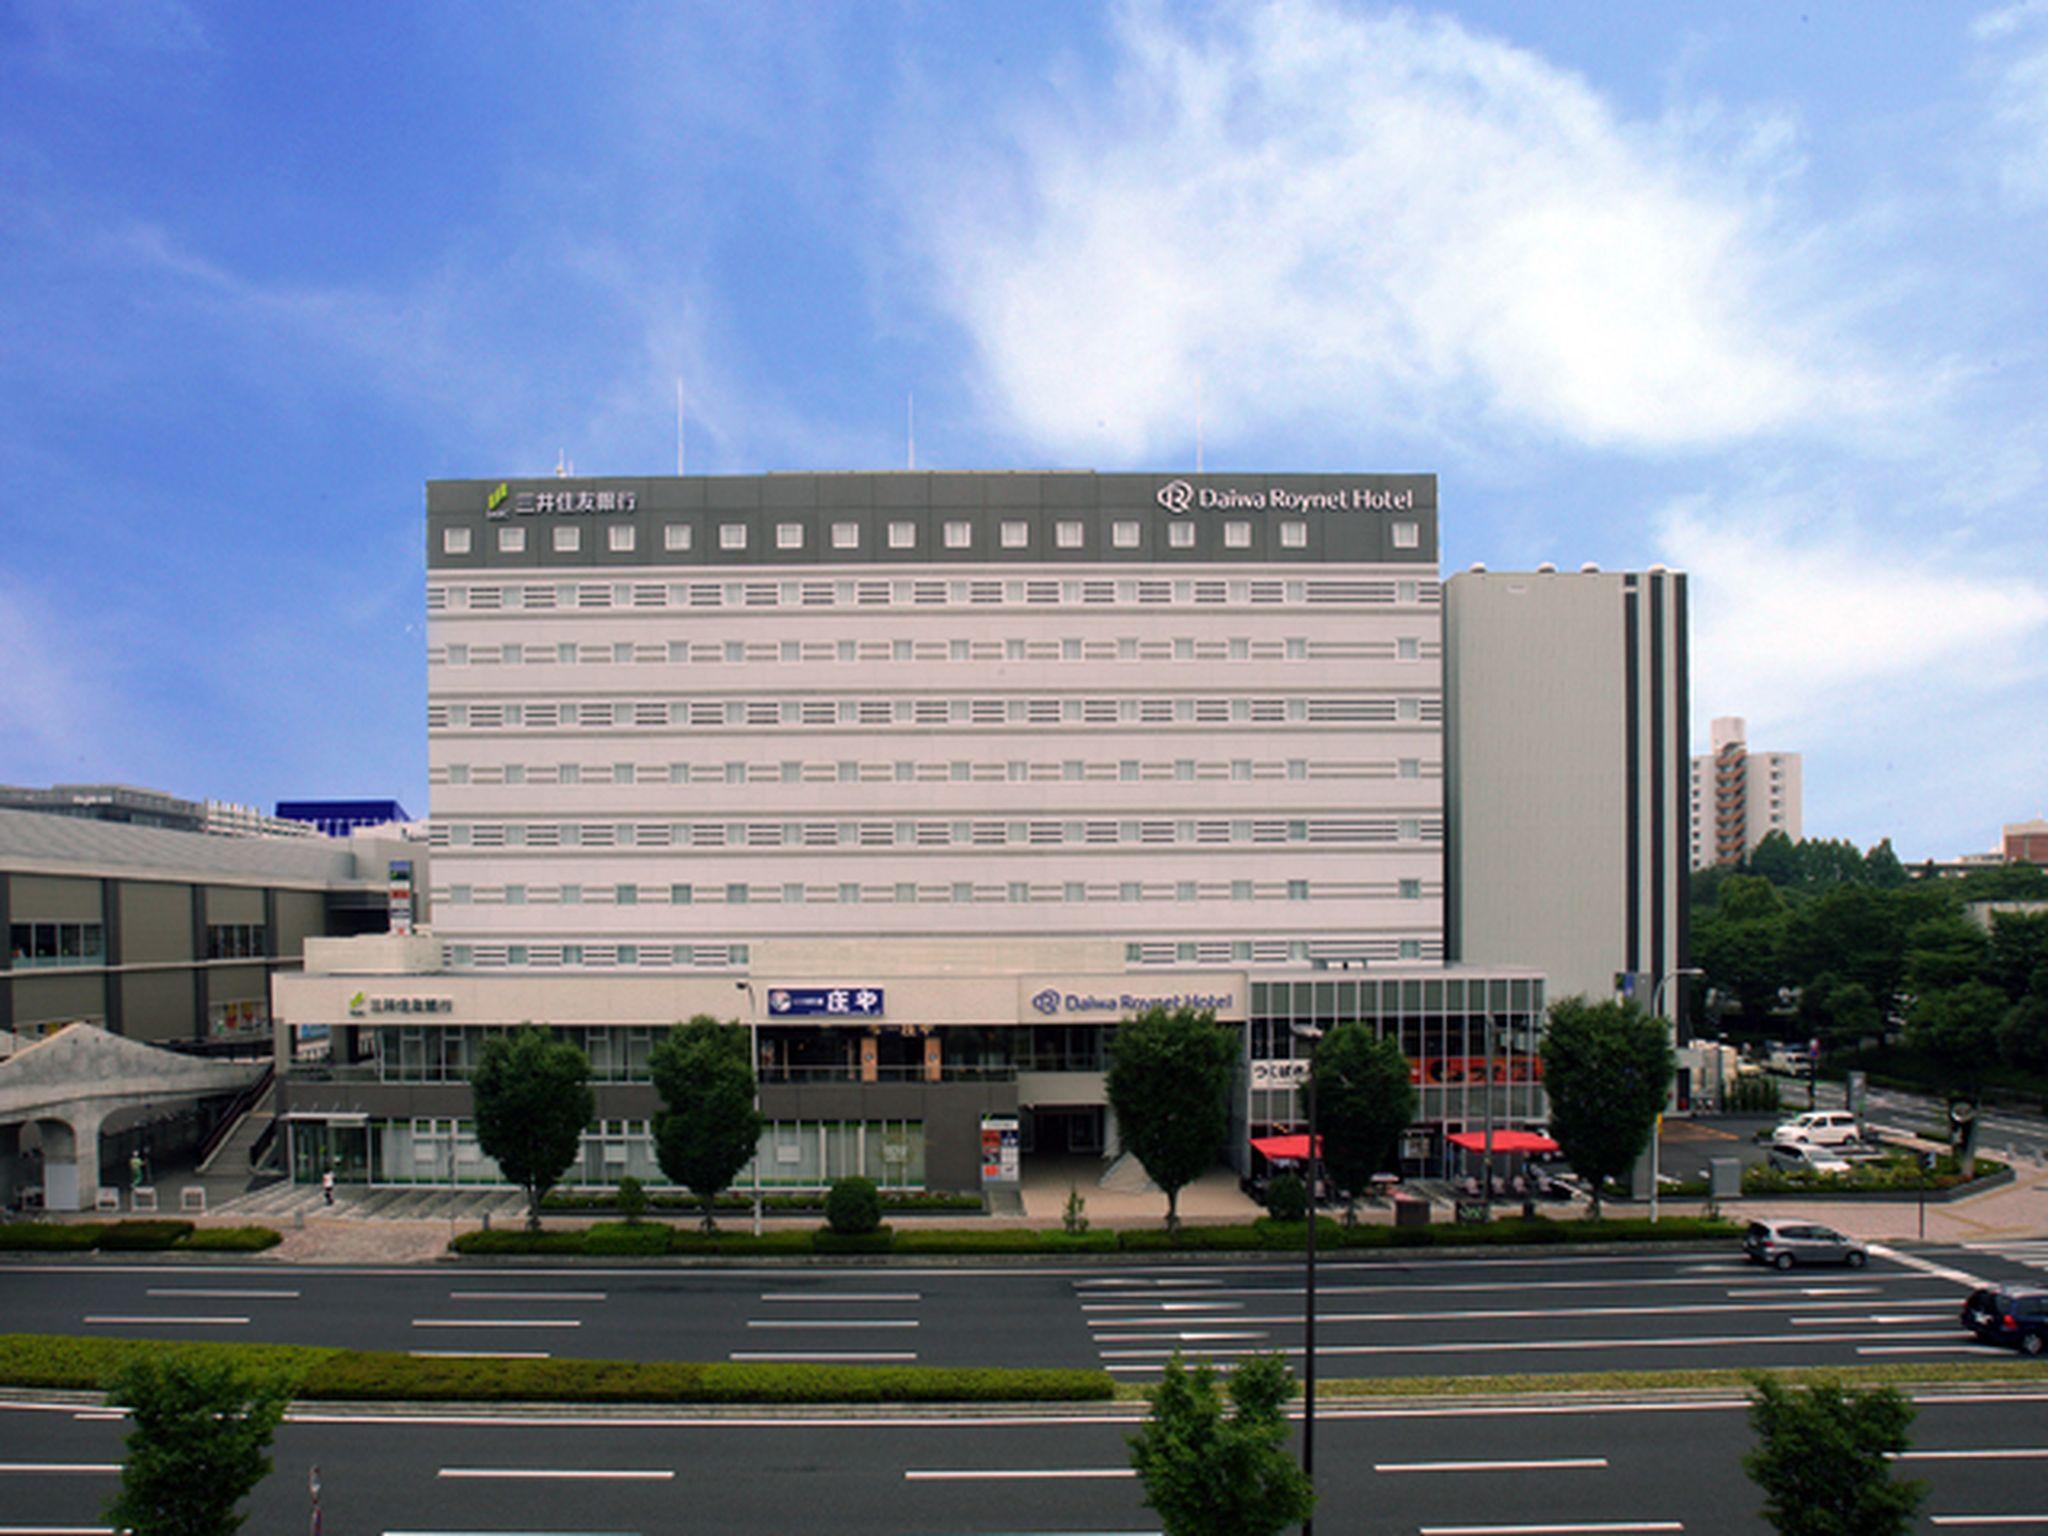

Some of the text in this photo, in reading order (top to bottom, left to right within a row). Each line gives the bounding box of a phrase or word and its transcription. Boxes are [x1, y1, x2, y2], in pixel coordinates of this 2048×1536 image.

[515, 491, 636, 513] 三井住友銀行
[1200, 488, 1413, 513] Daiwa Roynet Hotel
[1065, 994, 1118, 1011] Daiwa
[1185, 993, 1233, 1009] Hotel
